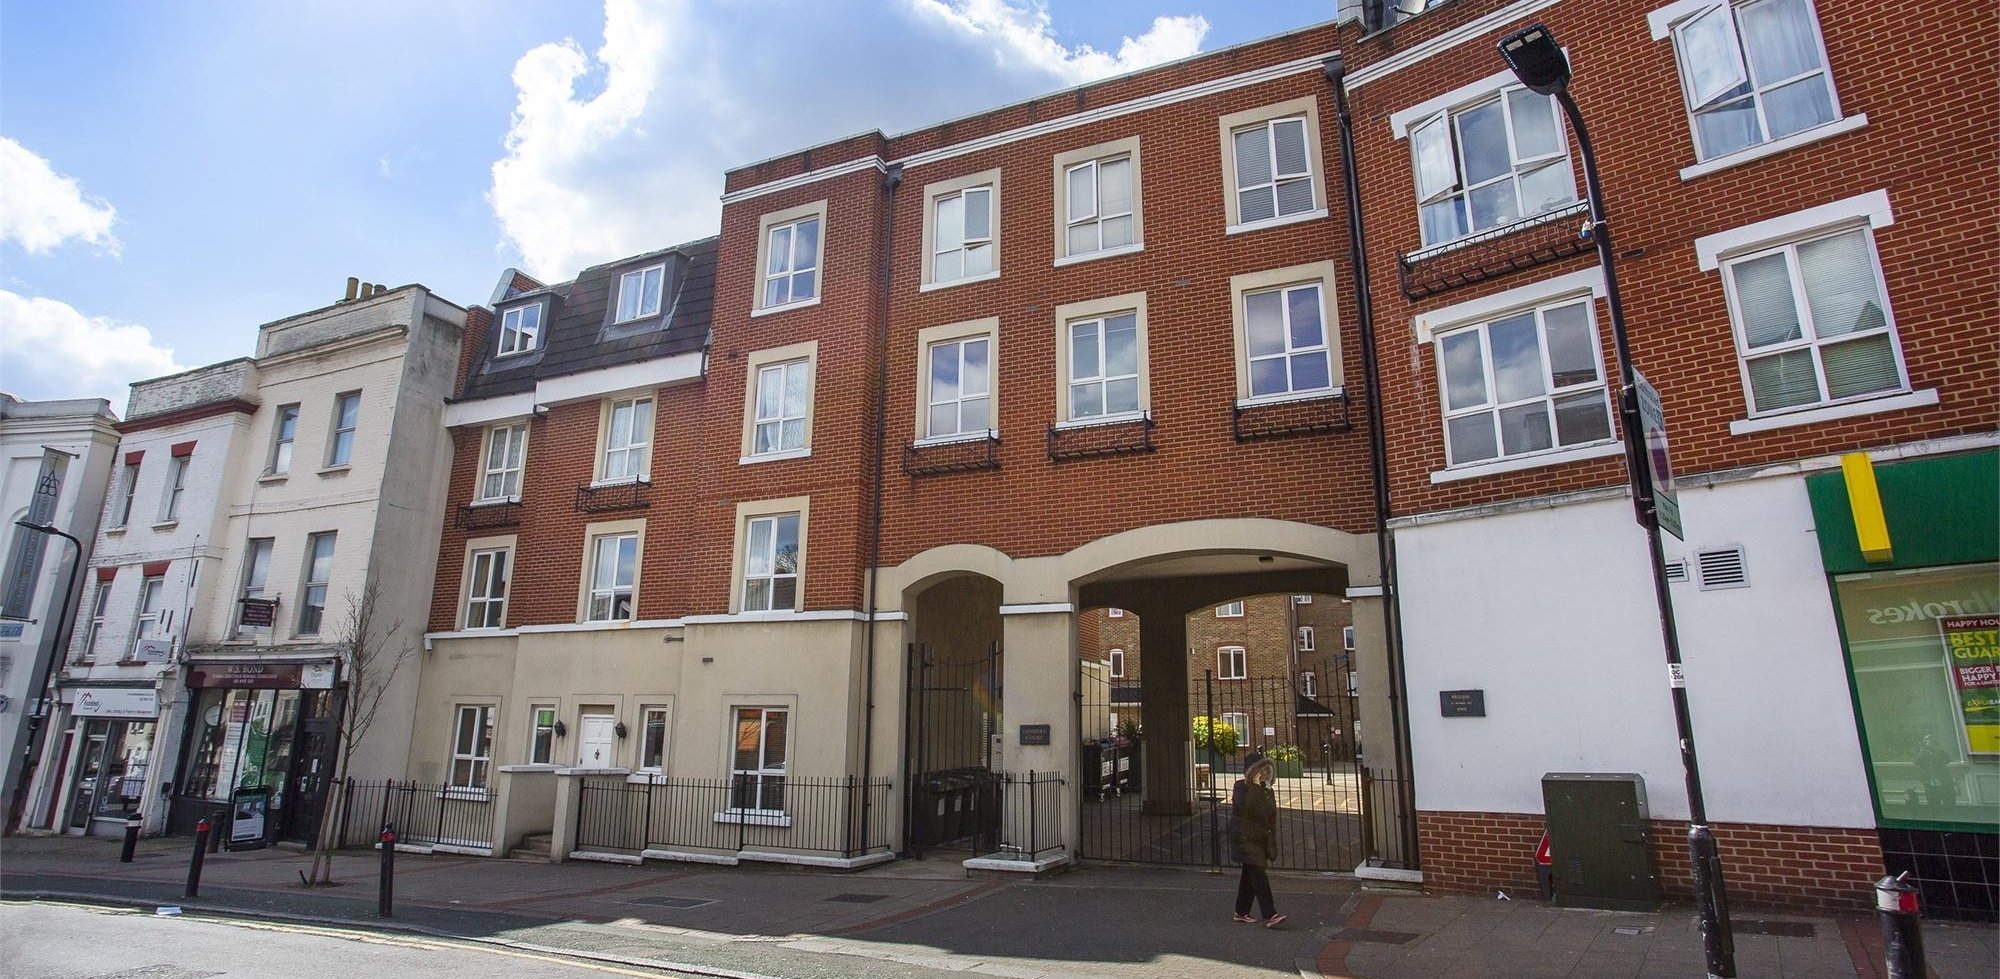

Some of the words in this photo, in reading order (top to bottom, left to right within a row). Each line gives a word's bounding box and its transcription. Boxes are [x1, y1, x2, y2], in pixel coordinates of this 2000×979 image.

[1946, 620, 1978, 628] HAPPY
[1949, 630, 1998, 647] BEST
[1961, 672, 1996, 682] HAPPY
